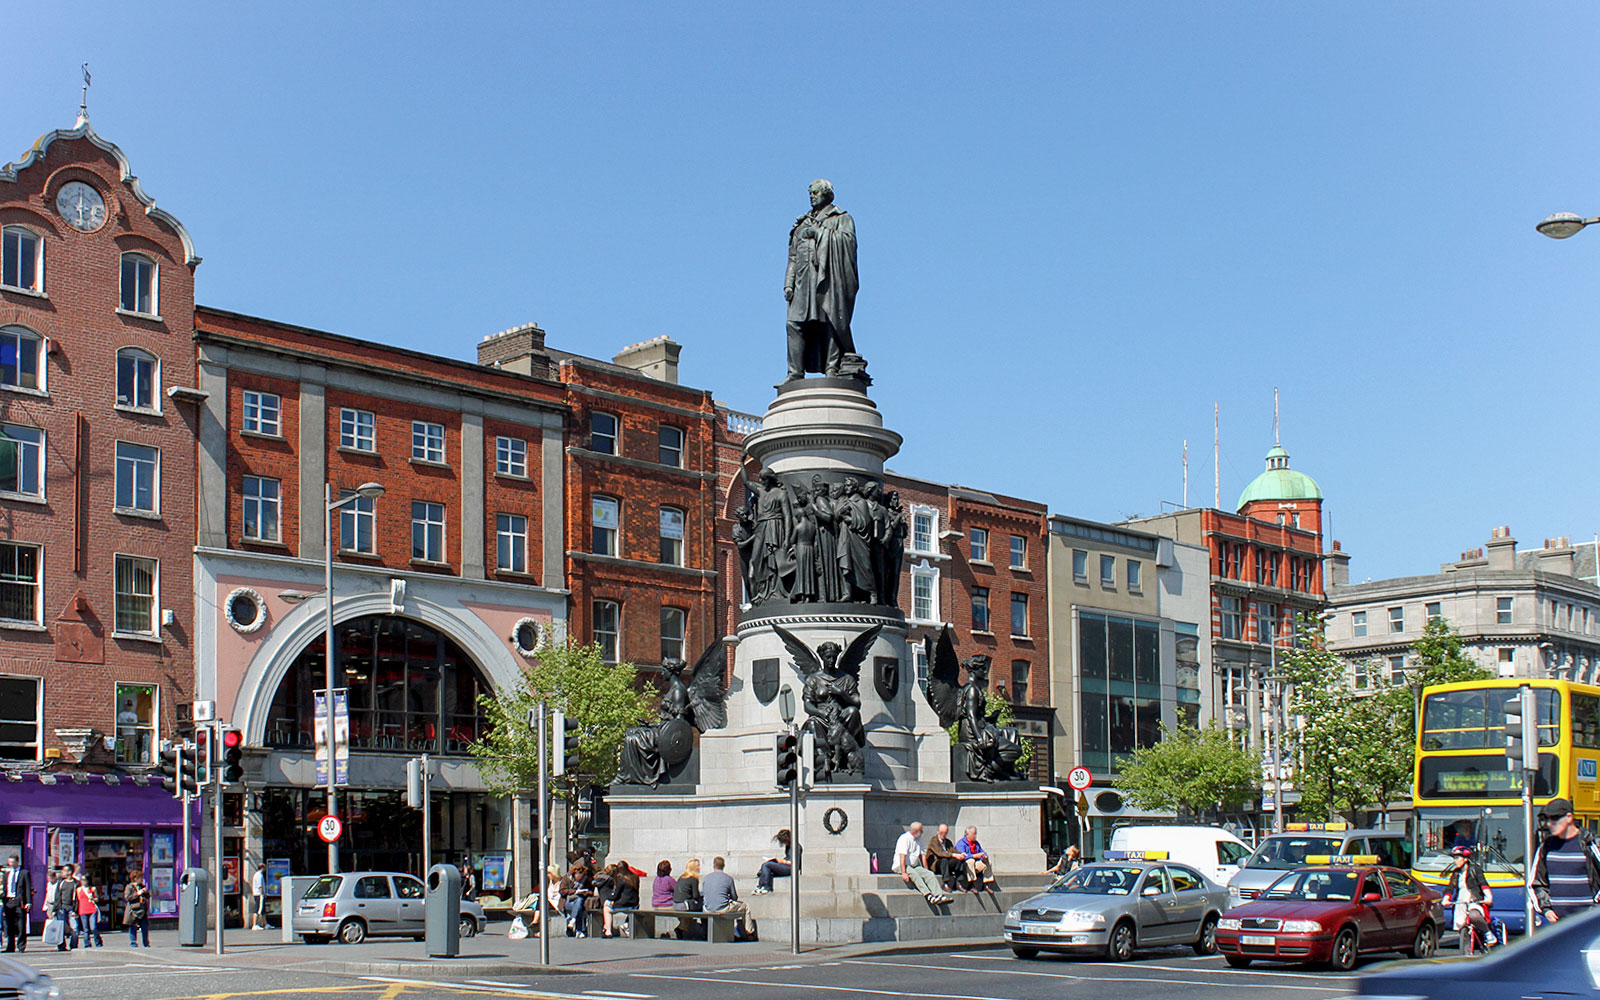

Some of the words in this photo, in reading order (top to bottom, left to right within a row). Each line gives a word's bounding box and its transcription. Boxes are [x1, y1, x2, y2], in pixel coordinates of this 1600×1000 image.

[1074, 771, 1085, 781] 30
[324, 820, 335, 831] 30
[592, 841, 603, 851] 52
[1332, 855, 1351, 863] TAXI
